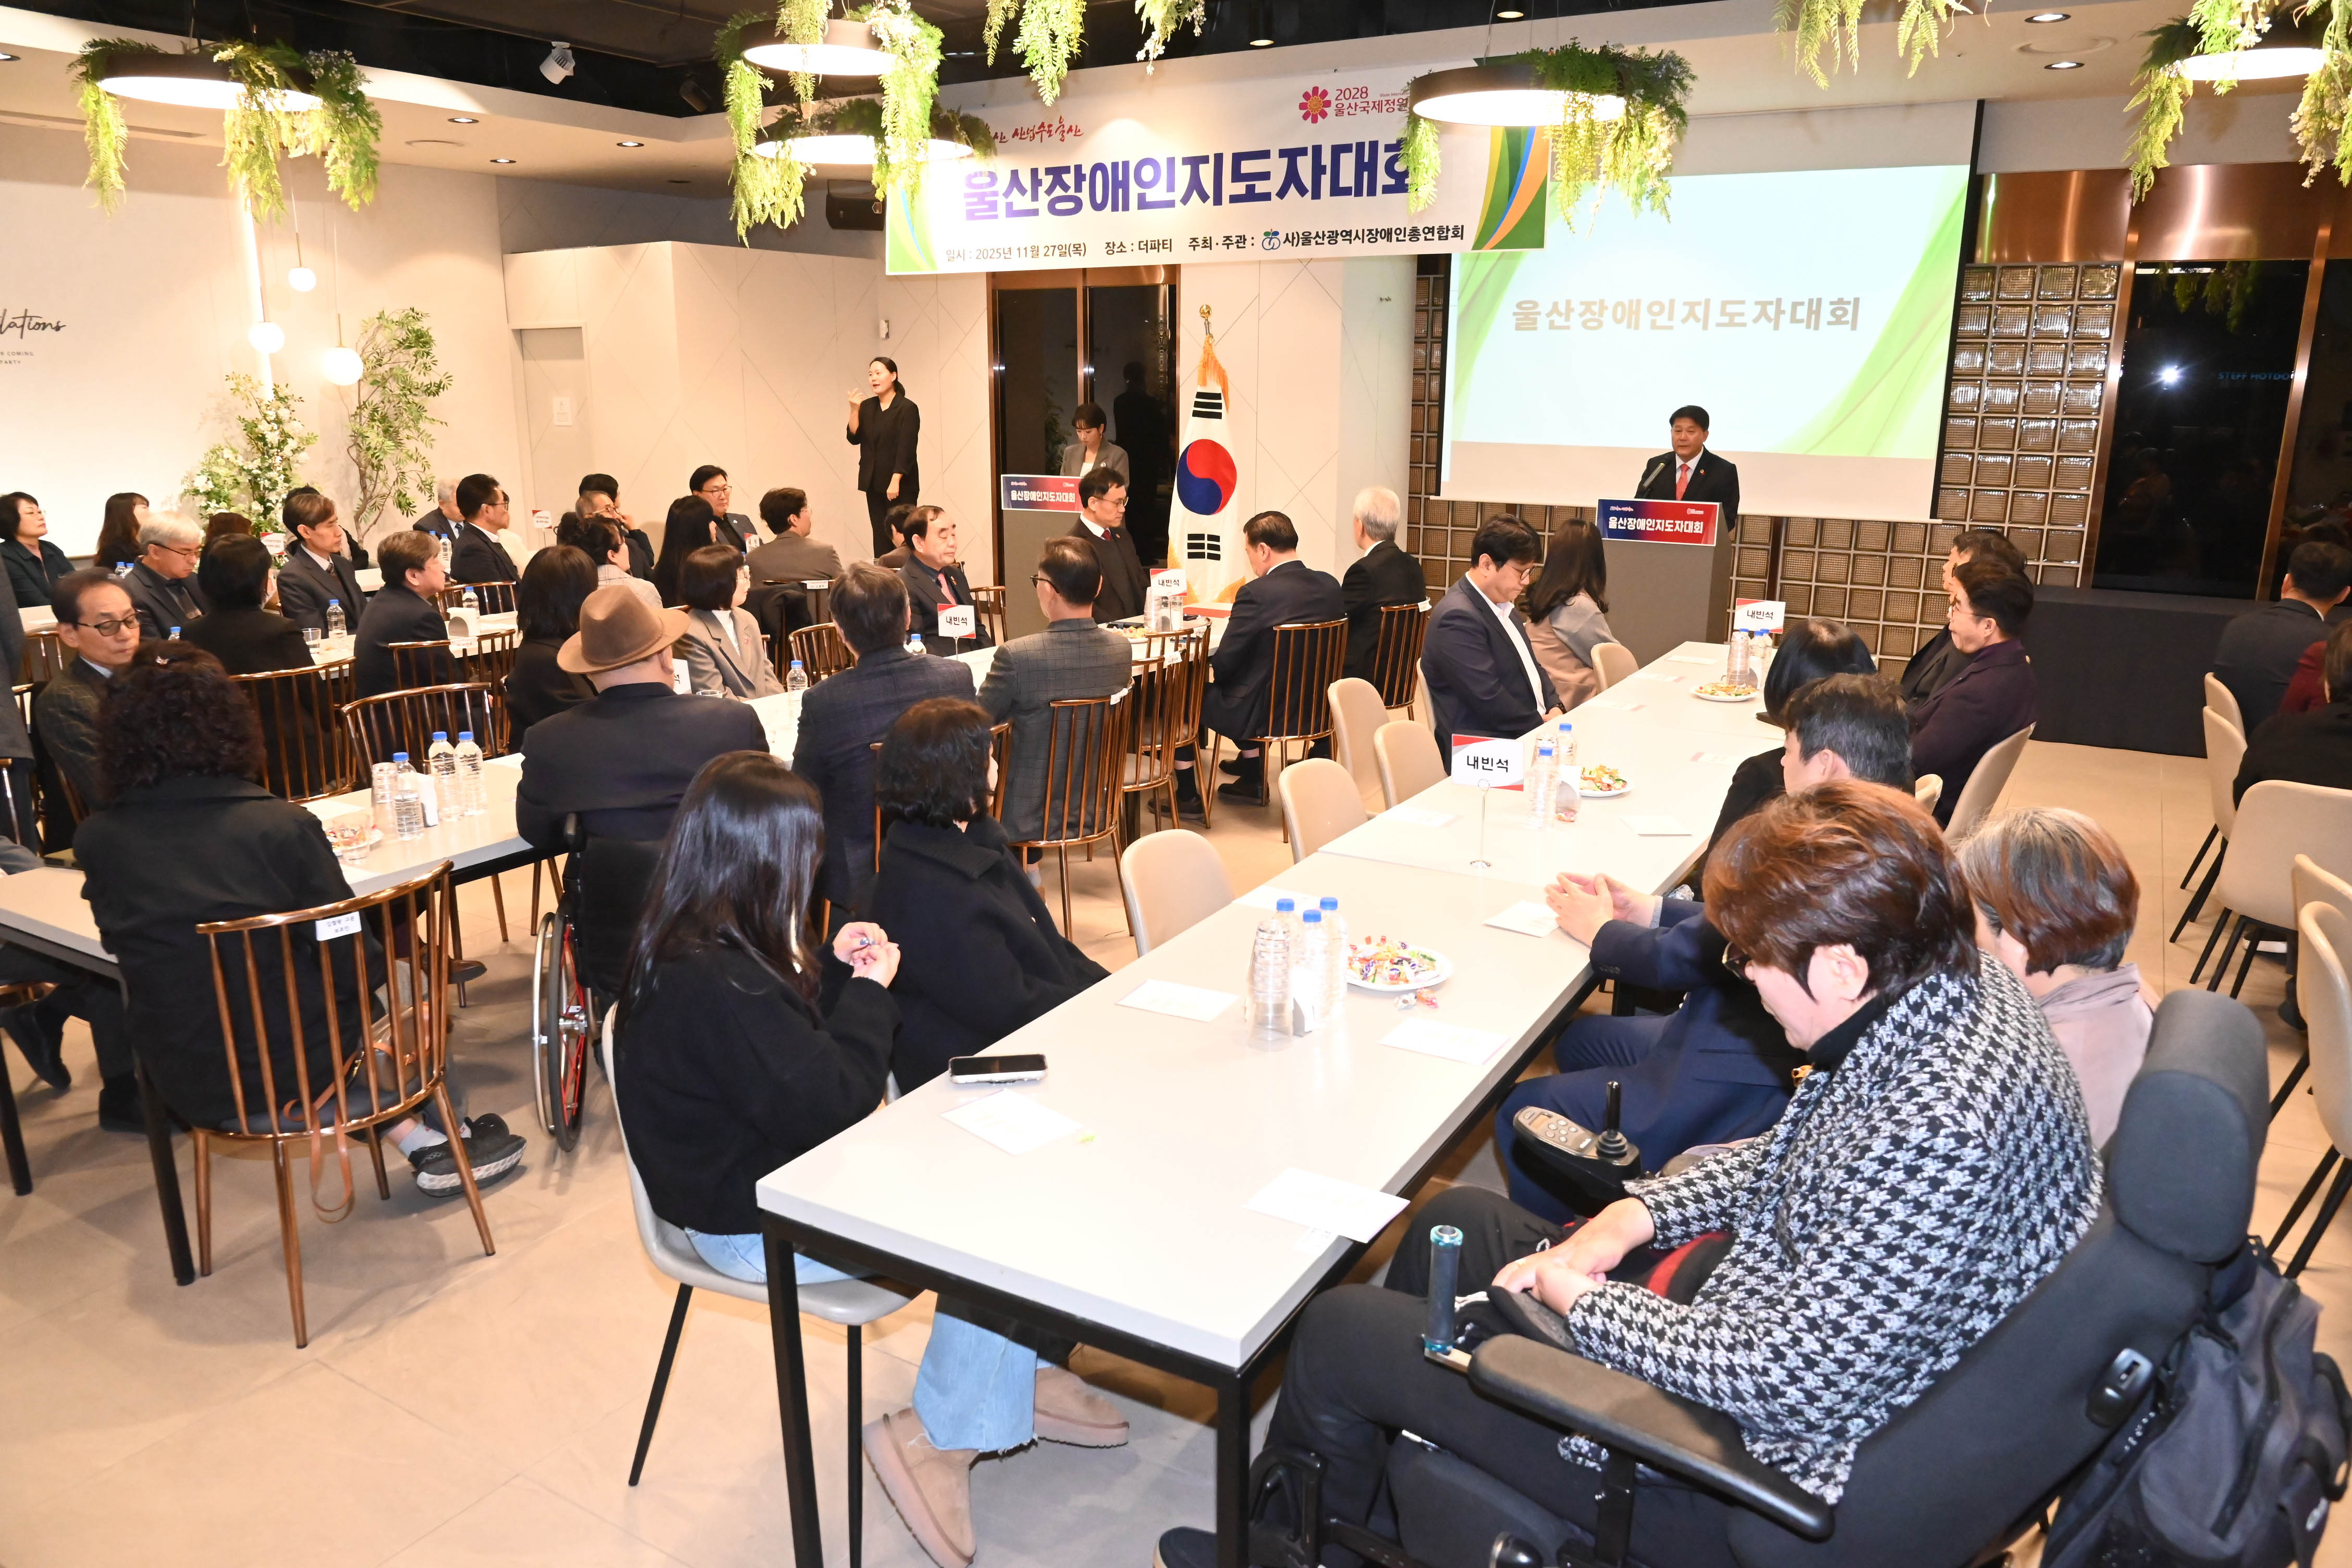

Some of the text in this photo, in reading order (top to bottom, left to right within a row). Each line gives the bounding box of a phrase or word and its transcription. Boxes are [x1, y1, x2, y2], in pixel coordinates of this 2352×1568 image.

[1335, 86, 1368, 101] 2028
[946, 249, 965, 262] 일시
[976, 247, 1012, 260] 2025년
[1016, 245, 1039, 259] 11월
[1043, 242, 1087, 258] 27일(목)
[1105, 241, 1127, 255] 장소
[1138, 239, 1172, 253] 더파티
[1283, 225, 1464, 247] 사)울산광역시장애인총연합회
[1512, 297, 1860, 332] 울산장애인지도자대회
[0, 309, 66, 339] lations
[2250, 372, 2290, 380] HOTDO
[1011, 490, 1075, 503] 울산장애인지도자대회
[1609, 517, 1704, 534] 울산장애인지도자대회
[946, 616, 967, 626] 내빈석
[1747, 610, 1773, 620] 내빈석
[1466, 755, 1509, 773] 내빈석
